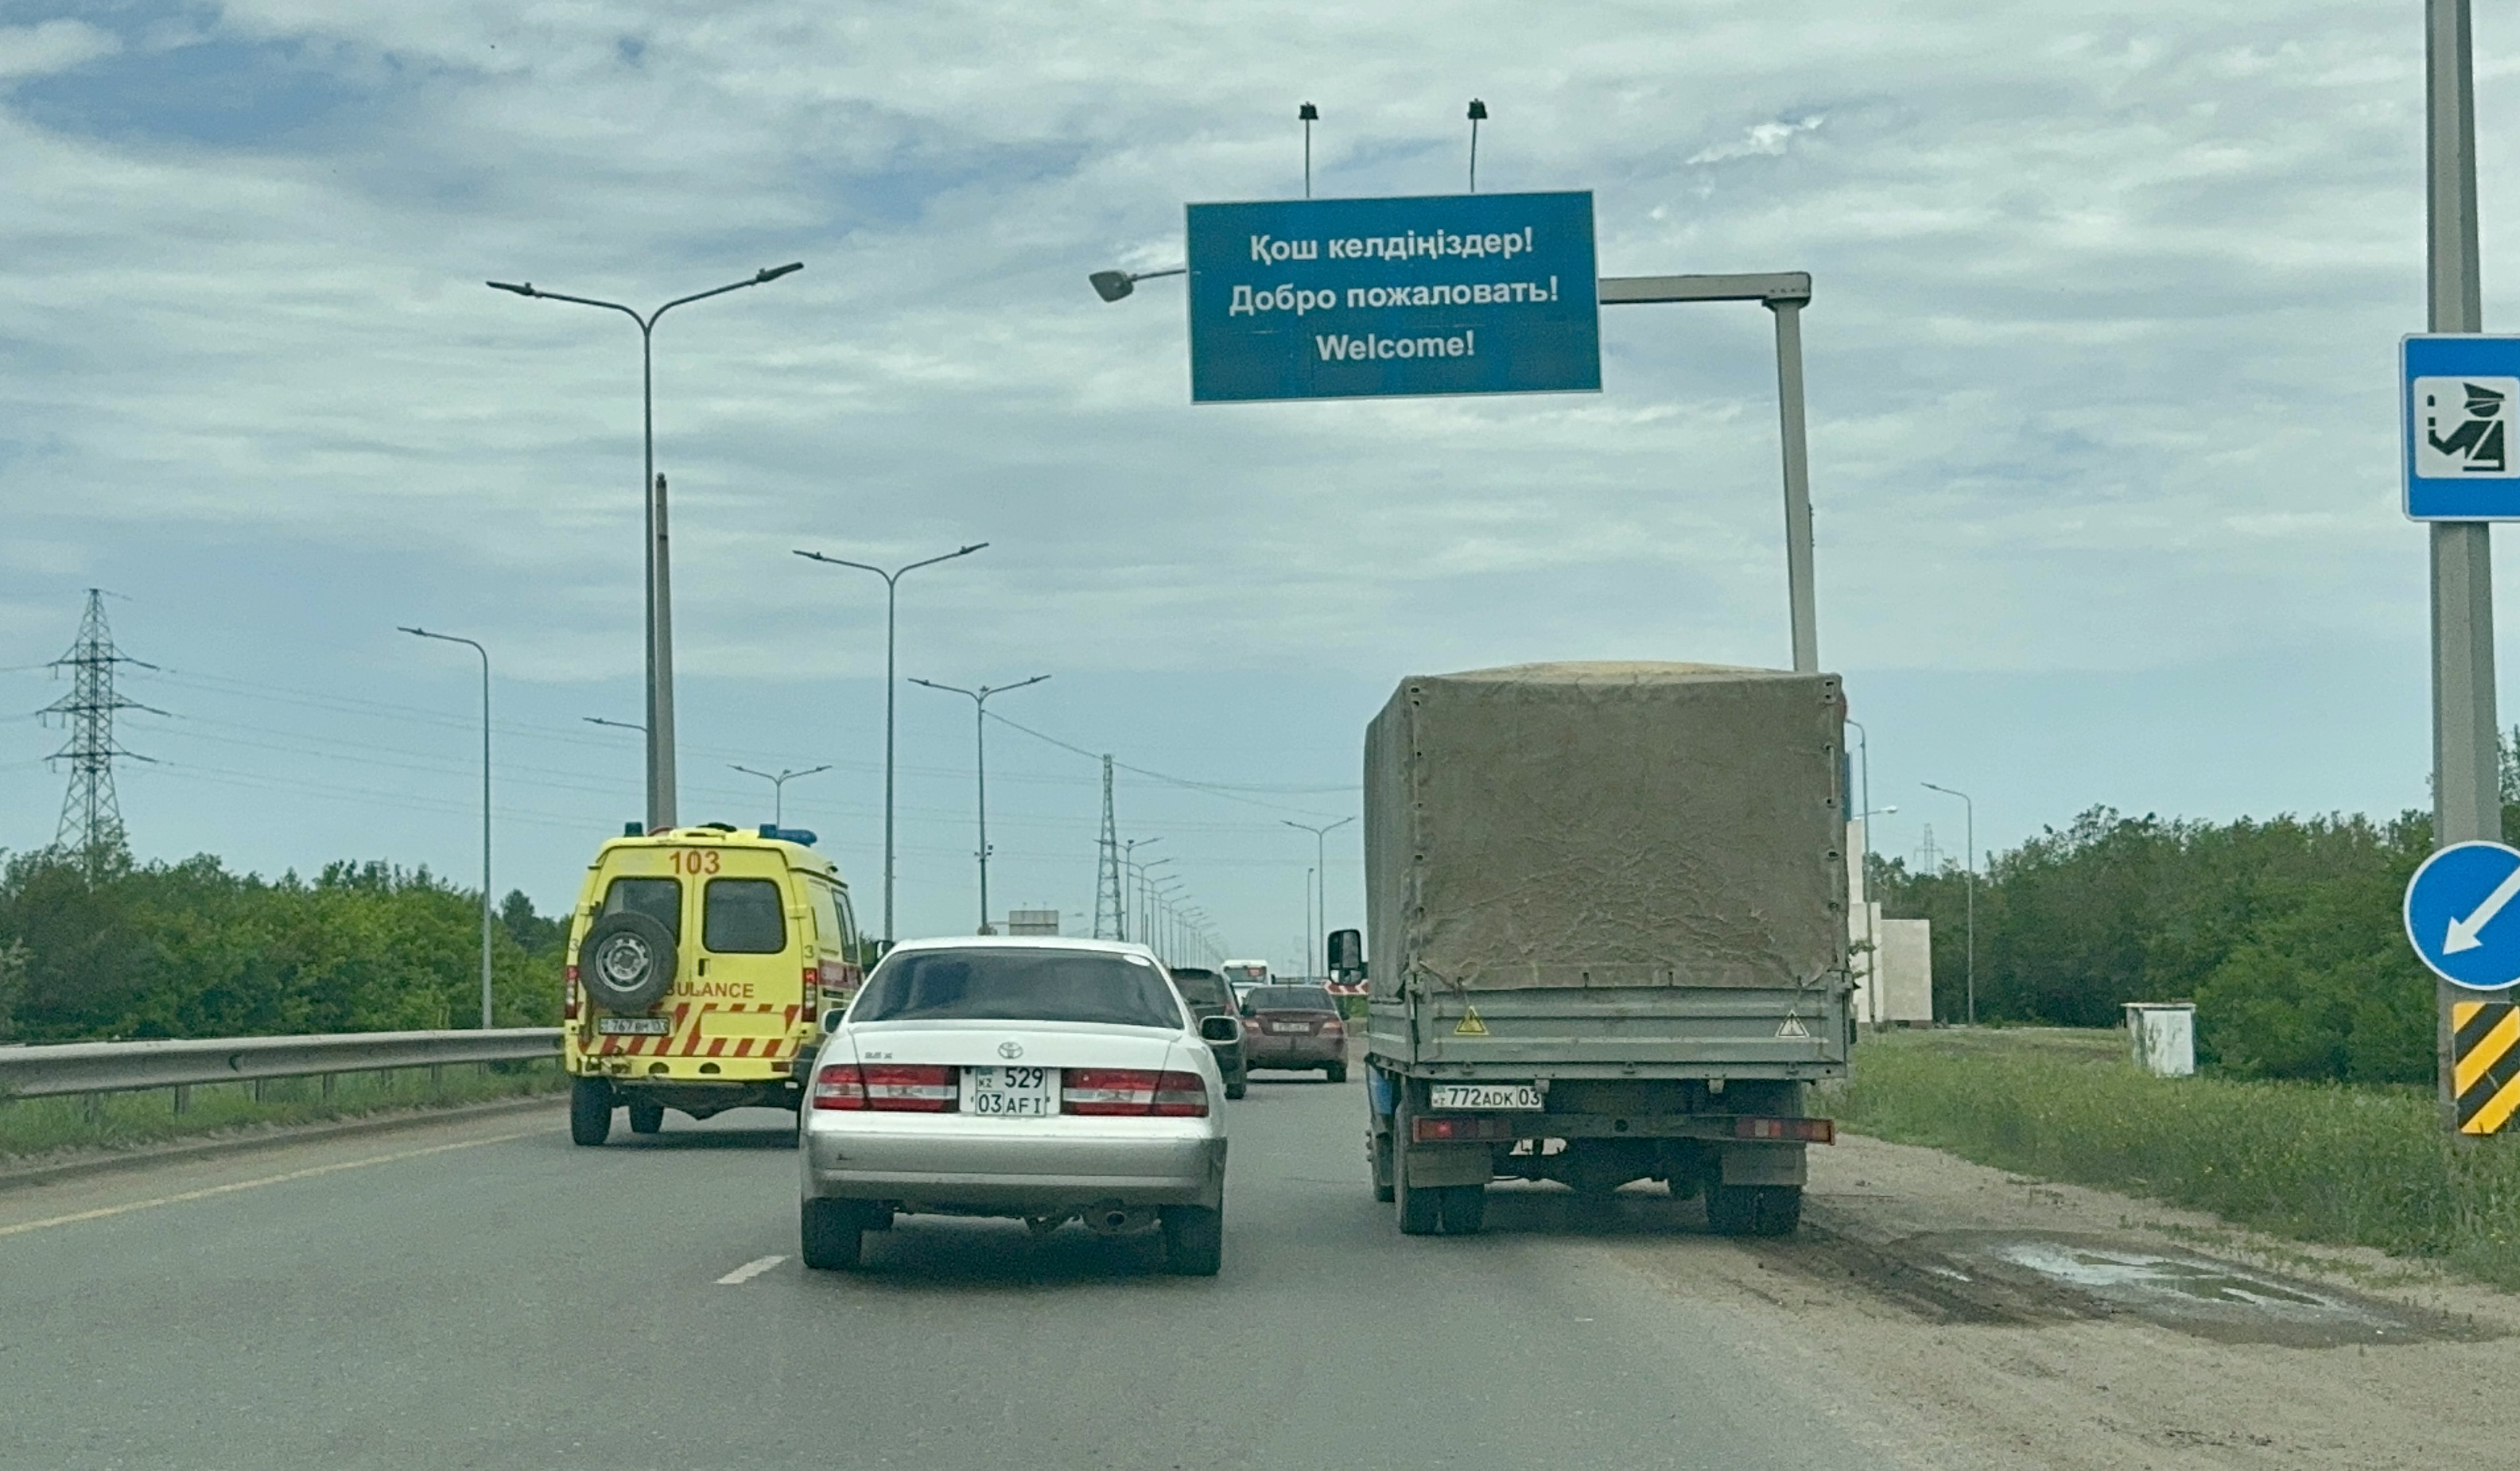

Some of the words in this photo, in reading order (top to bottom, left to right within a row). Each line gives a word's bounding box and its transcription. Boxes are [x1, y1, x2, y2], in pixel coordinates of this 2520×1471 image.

[1250, 235, 1318, 266] Қош
[1329, 226, 1533, 262] келдіңіздер!
[1229, 283, 1337, 316] Добро
[1347, 275, 1559, 309] пожаловать!
[1315, 329, 1475, 361] Welcome!
[670, 851, 720, 875] 103
[1005, 1066, 1044, 1089] 529
[978, 1094, 1002, 1113] 03
[1006, 1097, 1042, 1114] AFI
[1518, 1089, 1540, 1106] 03
